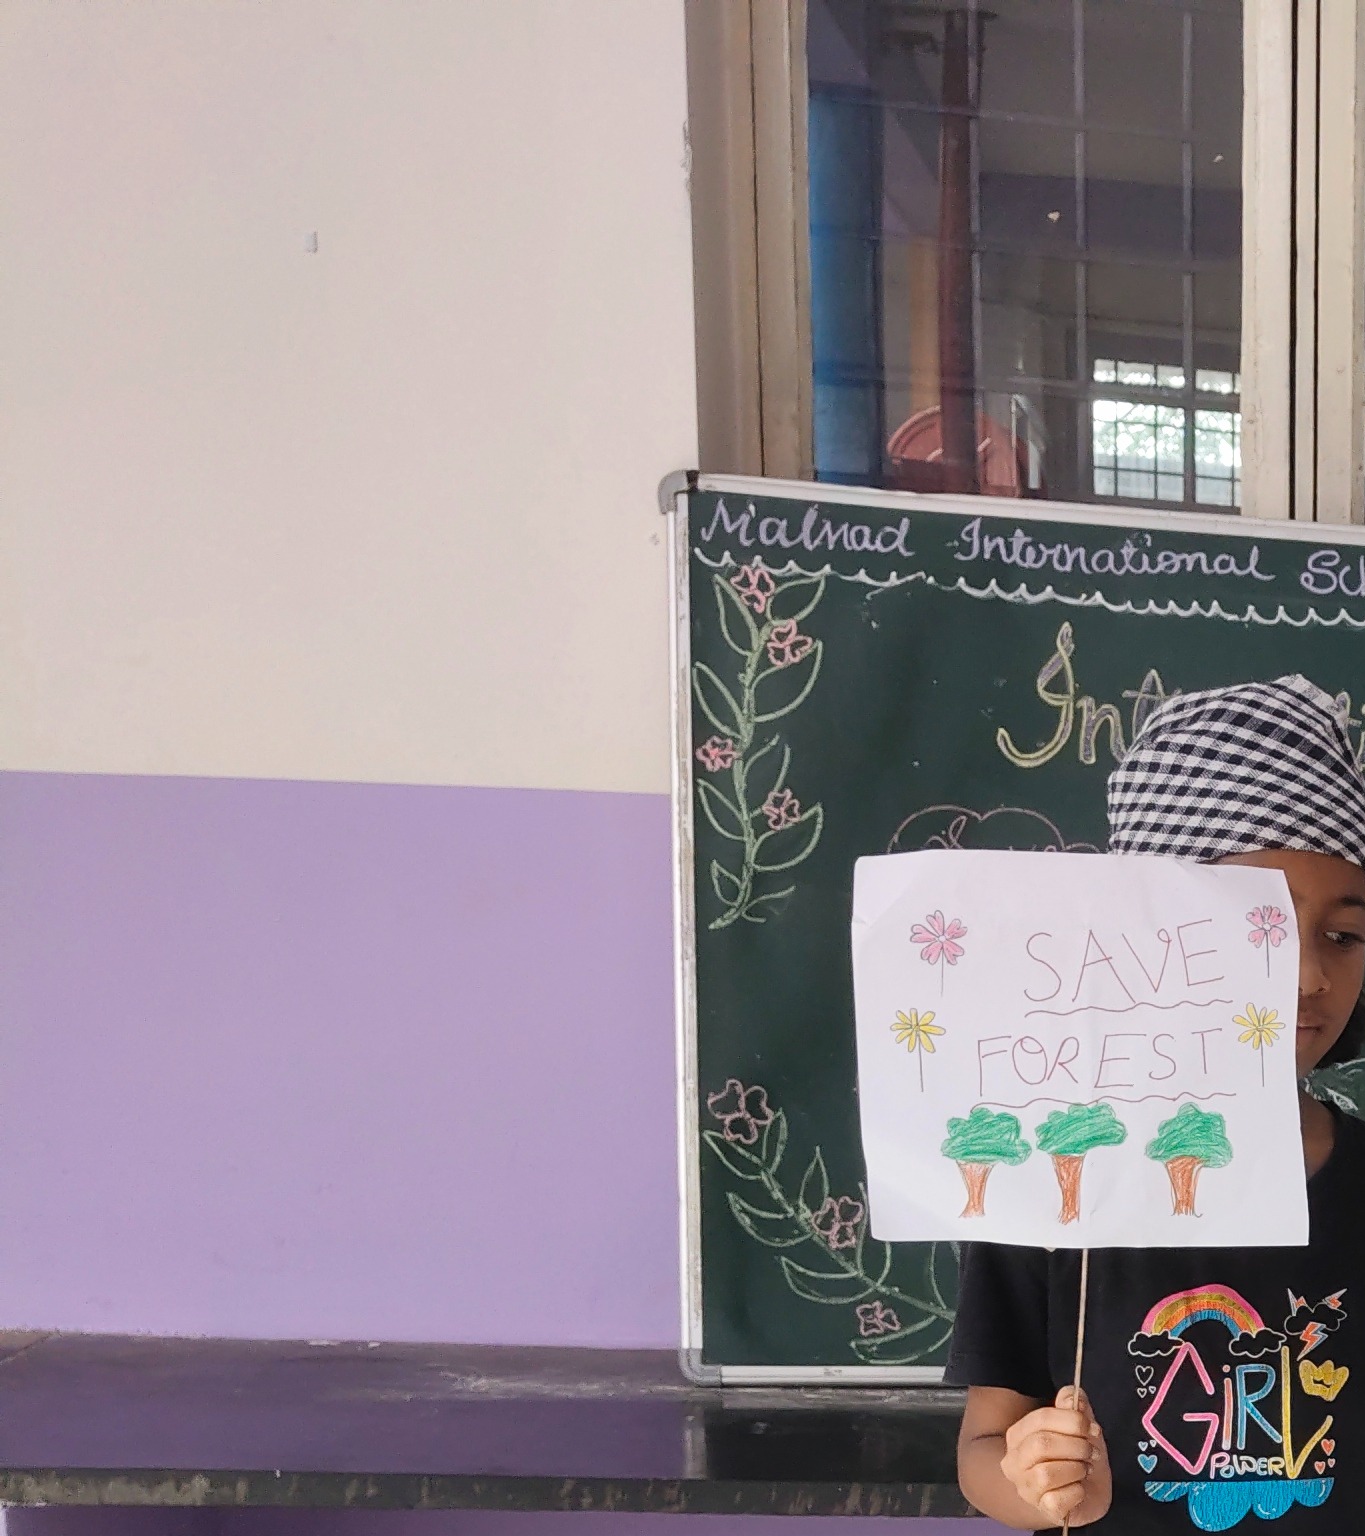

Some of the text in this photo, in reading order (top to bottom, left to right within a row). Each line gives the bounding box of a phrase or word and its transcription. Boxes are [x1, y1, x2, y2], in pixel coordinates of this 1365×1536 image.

[701, 499, 915, 557] Malnad
[954, 516, 1275, 581] International
[1023, 918, 1225, 1004] SAVE
[977, 1027, 1223, 1098] FOREST
